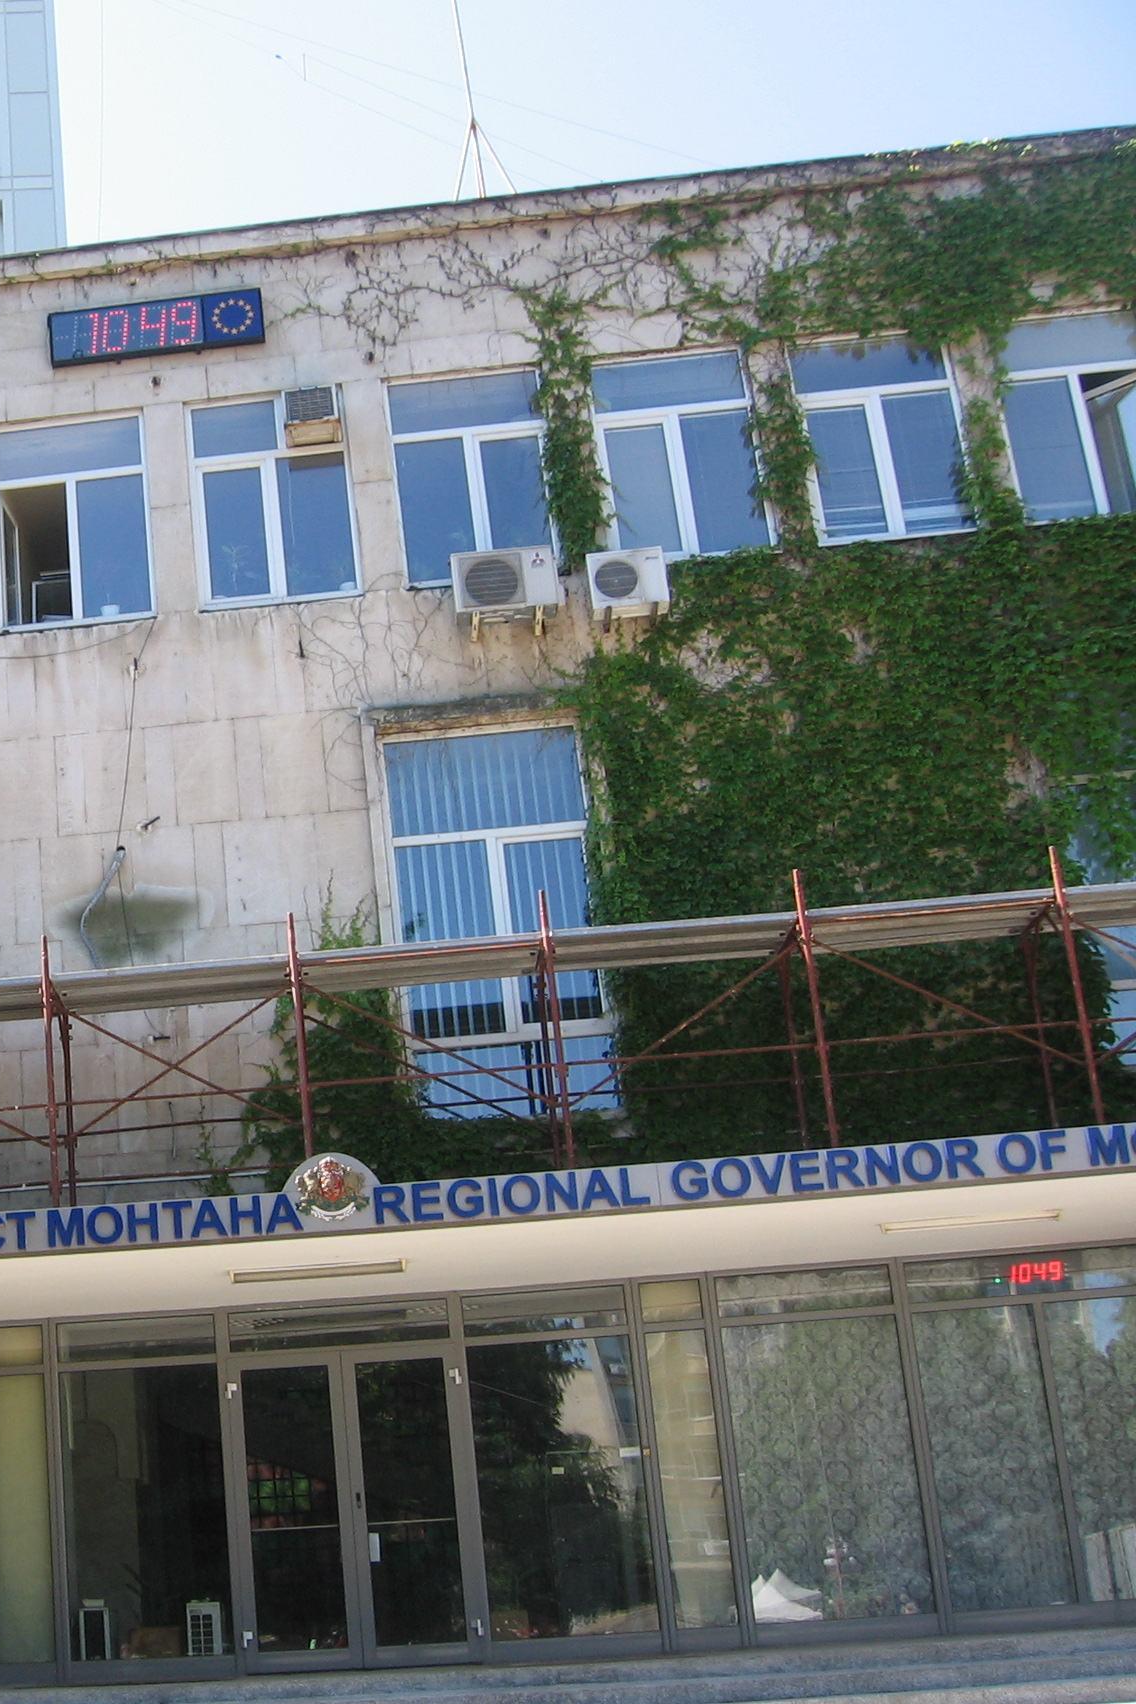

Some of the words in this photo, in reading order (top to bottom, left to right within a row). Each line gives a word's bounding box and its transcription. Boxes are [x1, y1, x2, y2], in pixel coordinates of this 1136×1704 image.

[373, 1167, 651, 1224] REGIONAL
[671, 1138, 985, 1201] GOVERNOR
[996, 1130, 1067, 1174] OF
[1086, 1125, 1136, 1167] M
[47, 1193, 303, 1248] МОНТАНА
